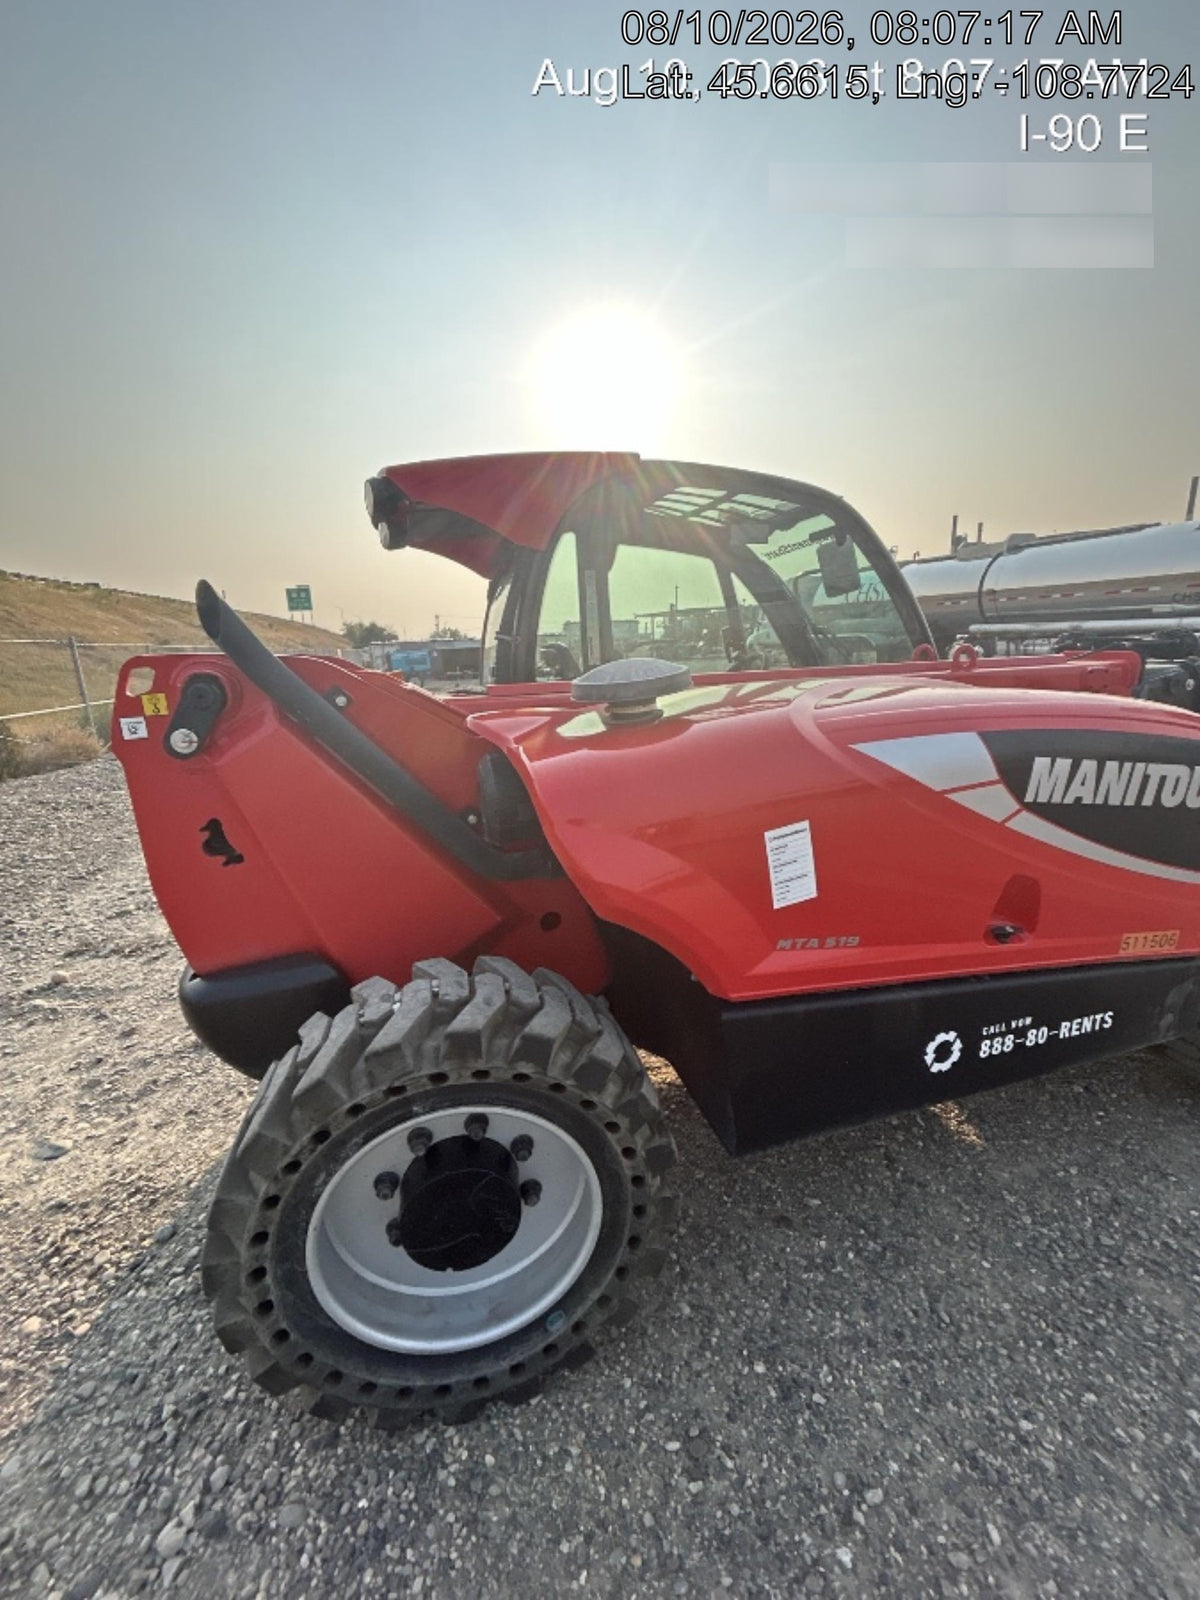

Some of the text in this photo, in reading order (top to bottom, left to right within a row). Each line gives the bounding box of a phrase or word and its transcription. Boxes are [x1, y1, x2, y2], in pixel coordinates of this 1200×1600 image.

[775, 938, 819, 950] MTA
[979, 1011, 1114, 1058] 888-80-RENTS
[982, 1016, 1033, 1036] CALL NOW
